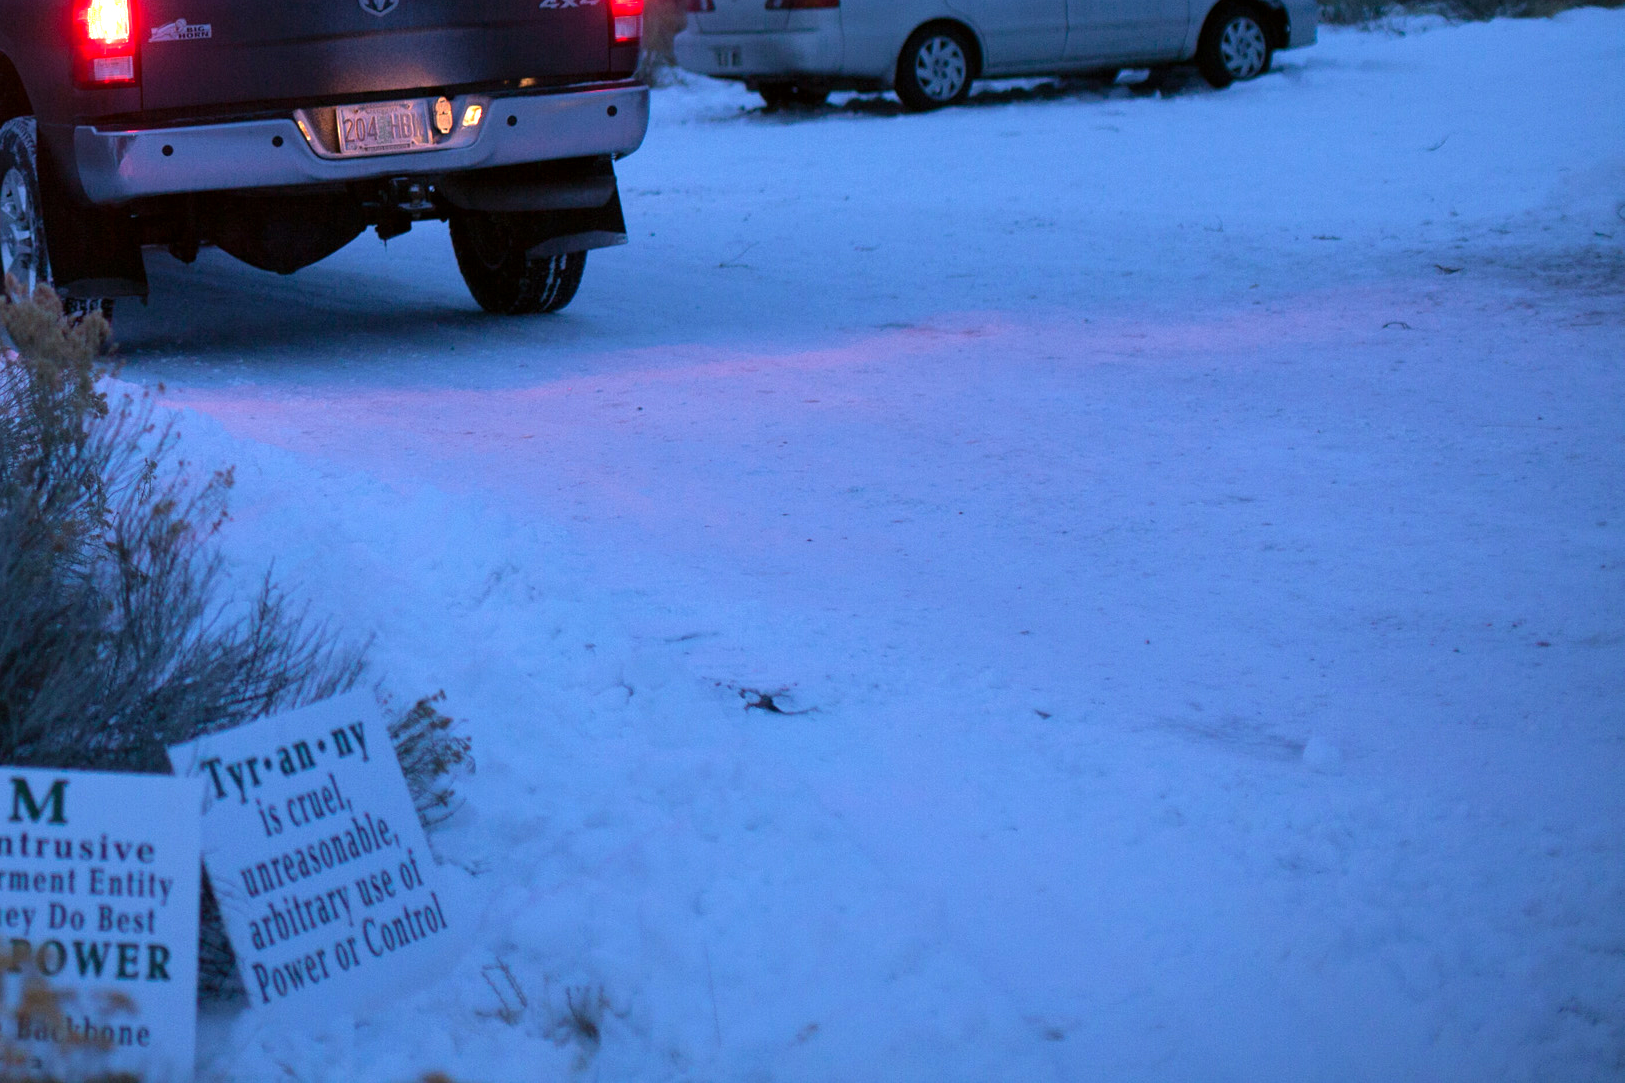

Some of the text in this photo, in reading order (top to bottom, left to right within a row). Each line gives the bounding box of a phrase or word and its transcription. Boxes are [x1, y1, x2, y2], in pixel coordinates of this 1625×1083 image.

[186, 25, 205, 33] BIG
[343, 115, 378, 143] 204
[256, 772, 353, 837] is cruel,
[240, 812, 401, 899] unreasonable,
[88, 866, 175, 907] Entity
[249, 848, 425, 951] arbitrary use of
[47, 901, 86, 932] Do
[97, 903, 156, 936] Best
[9, 937, 173, 982] POWER
[251, 890, 448, 1004] Power or Control
